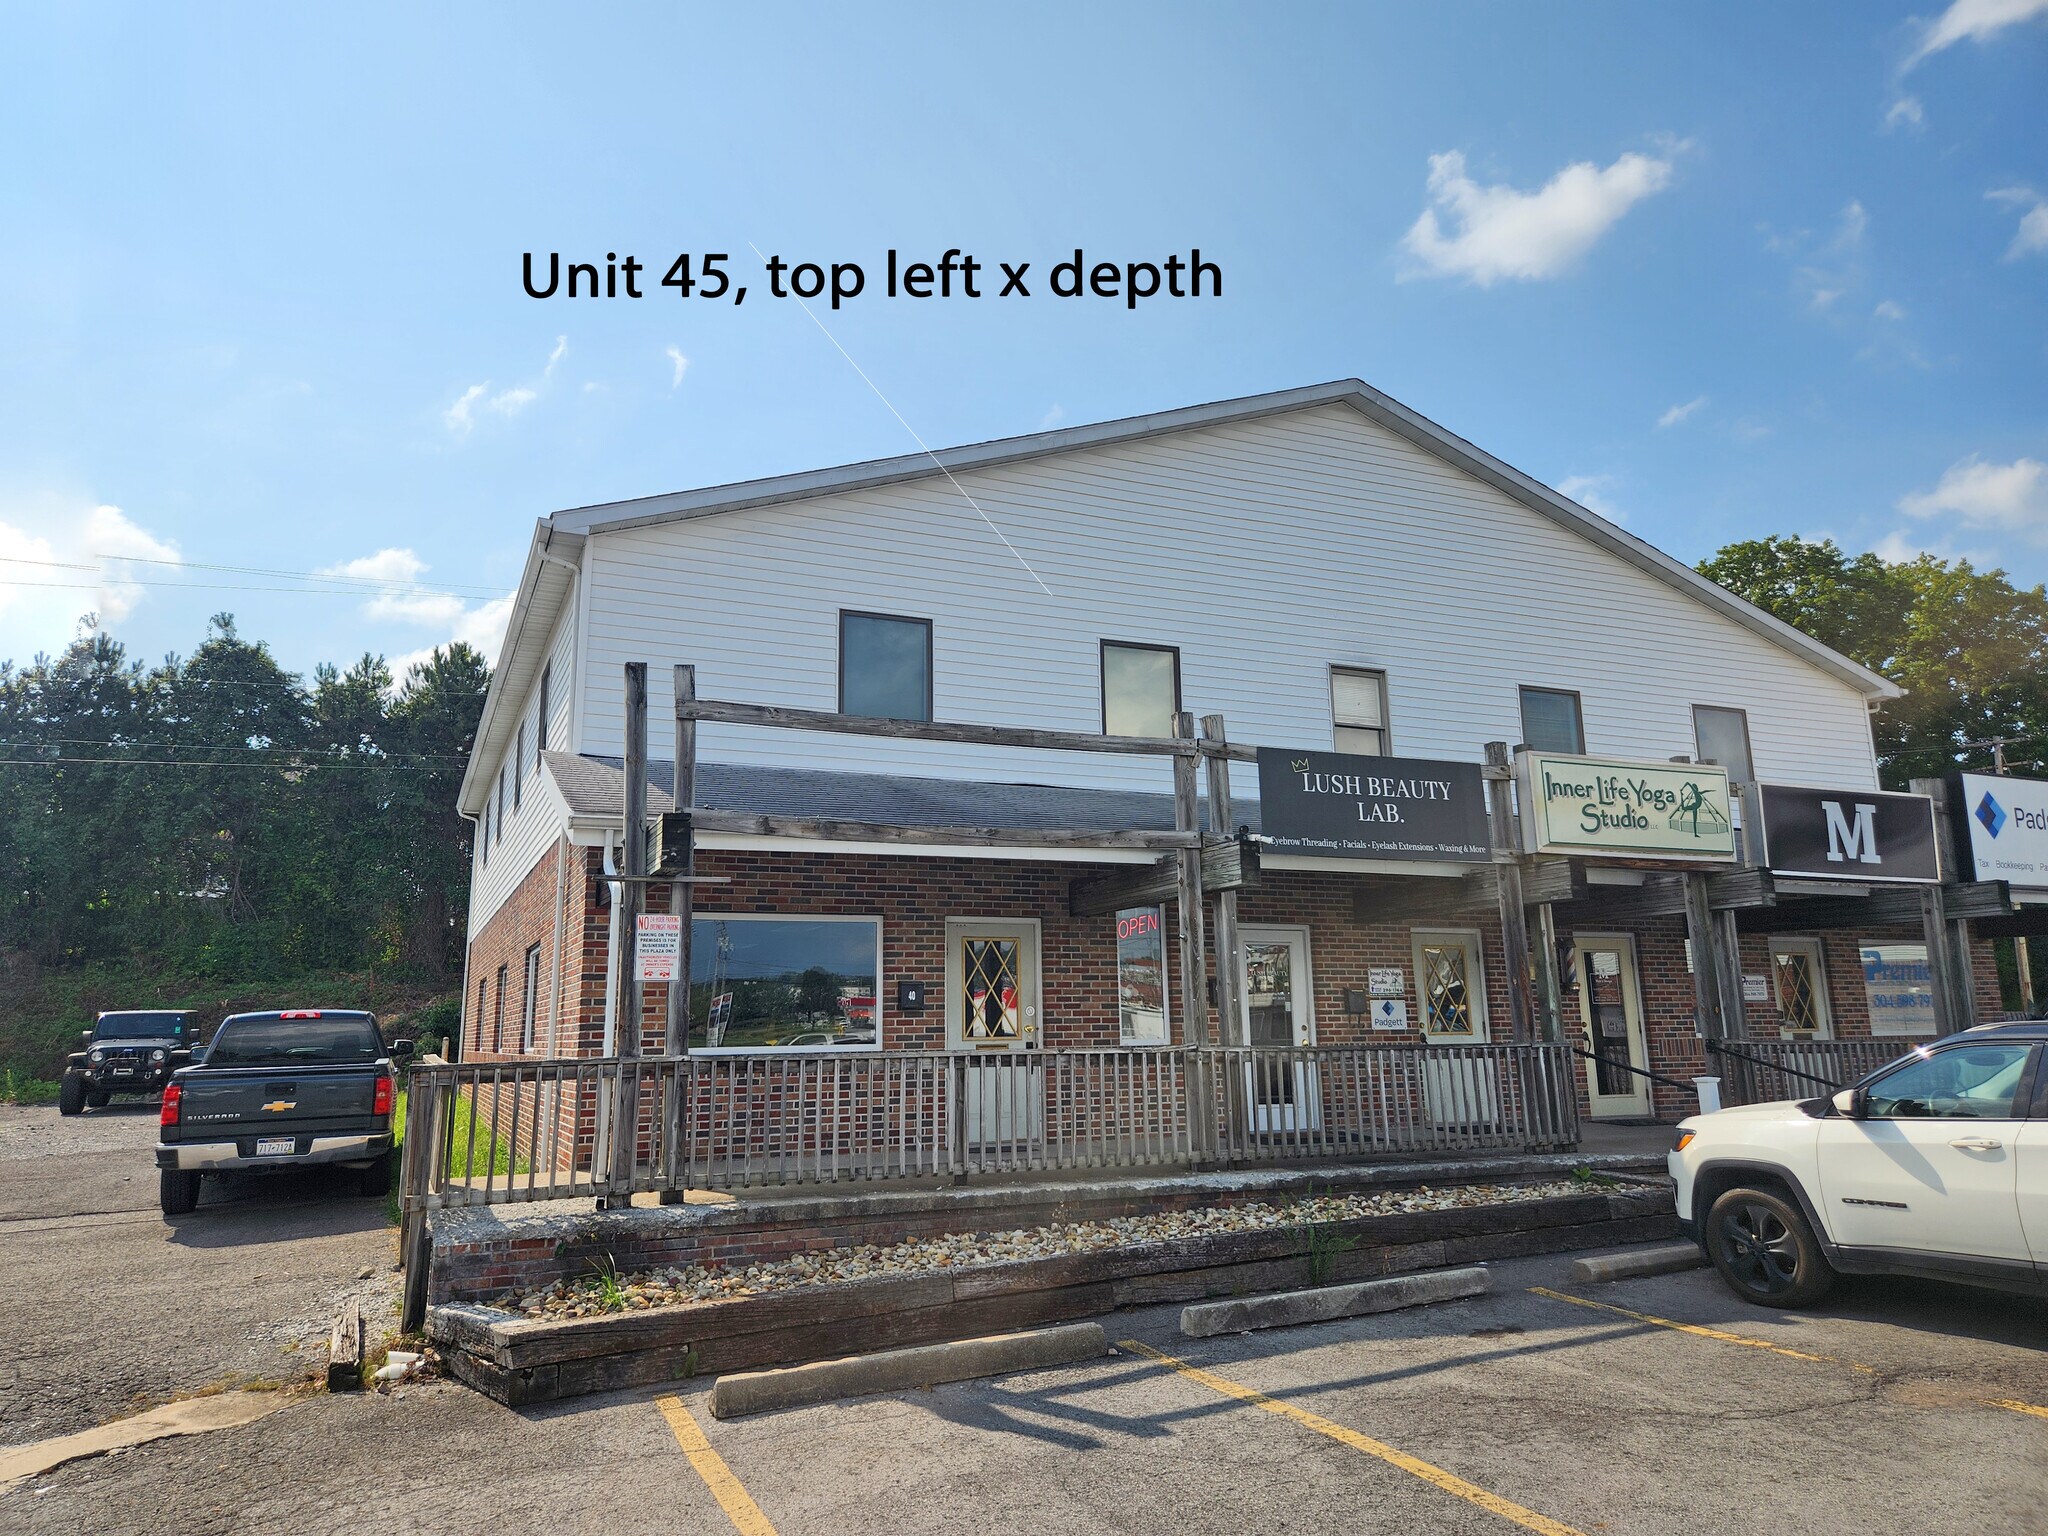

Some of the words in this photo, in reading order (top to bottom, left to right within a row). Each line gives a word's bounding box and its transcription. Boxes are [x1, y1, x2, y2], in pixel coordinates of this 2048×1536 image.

[1302, 772, 1362, 796] LUSH
[1367, 776, 1451, 800] BEAUTY
[1545, 771, 1594, 802] Inner
[1596, 775, 1629, 806] Life
[1627, 778, 1676, 811] Yoga
[1357, 801, 1405, 823] LAB.
[1580, 803, 1649, 833] Studio
[2013, 807, 2048, 831] Pad
[1821, 800, 1881, 864] M
[1270, 835, 1300, 847] Eyebrow
[1301, 837, 1338, 849] Threading
[1343, 839, 1366, 849] Facials
[1371, 840, 1398, 851] Eyelash
[1398, 841, 1434, 852] Extensions
[1438, 843, 1463, 854] Waxing
[1463, 844, 1469, 853] &
[1469, 844, 1486, 854] More
[1978, 858, 1989, 868] Tax
[1995, 859, 2034, 872] Bookkeeping
[638, 916, 649, 930] NO
[1117, 912, 1158, 939] OPEN
[908, 990, 916, 1001] 40
[1374, 1018, 1403, 1028] Padgett
